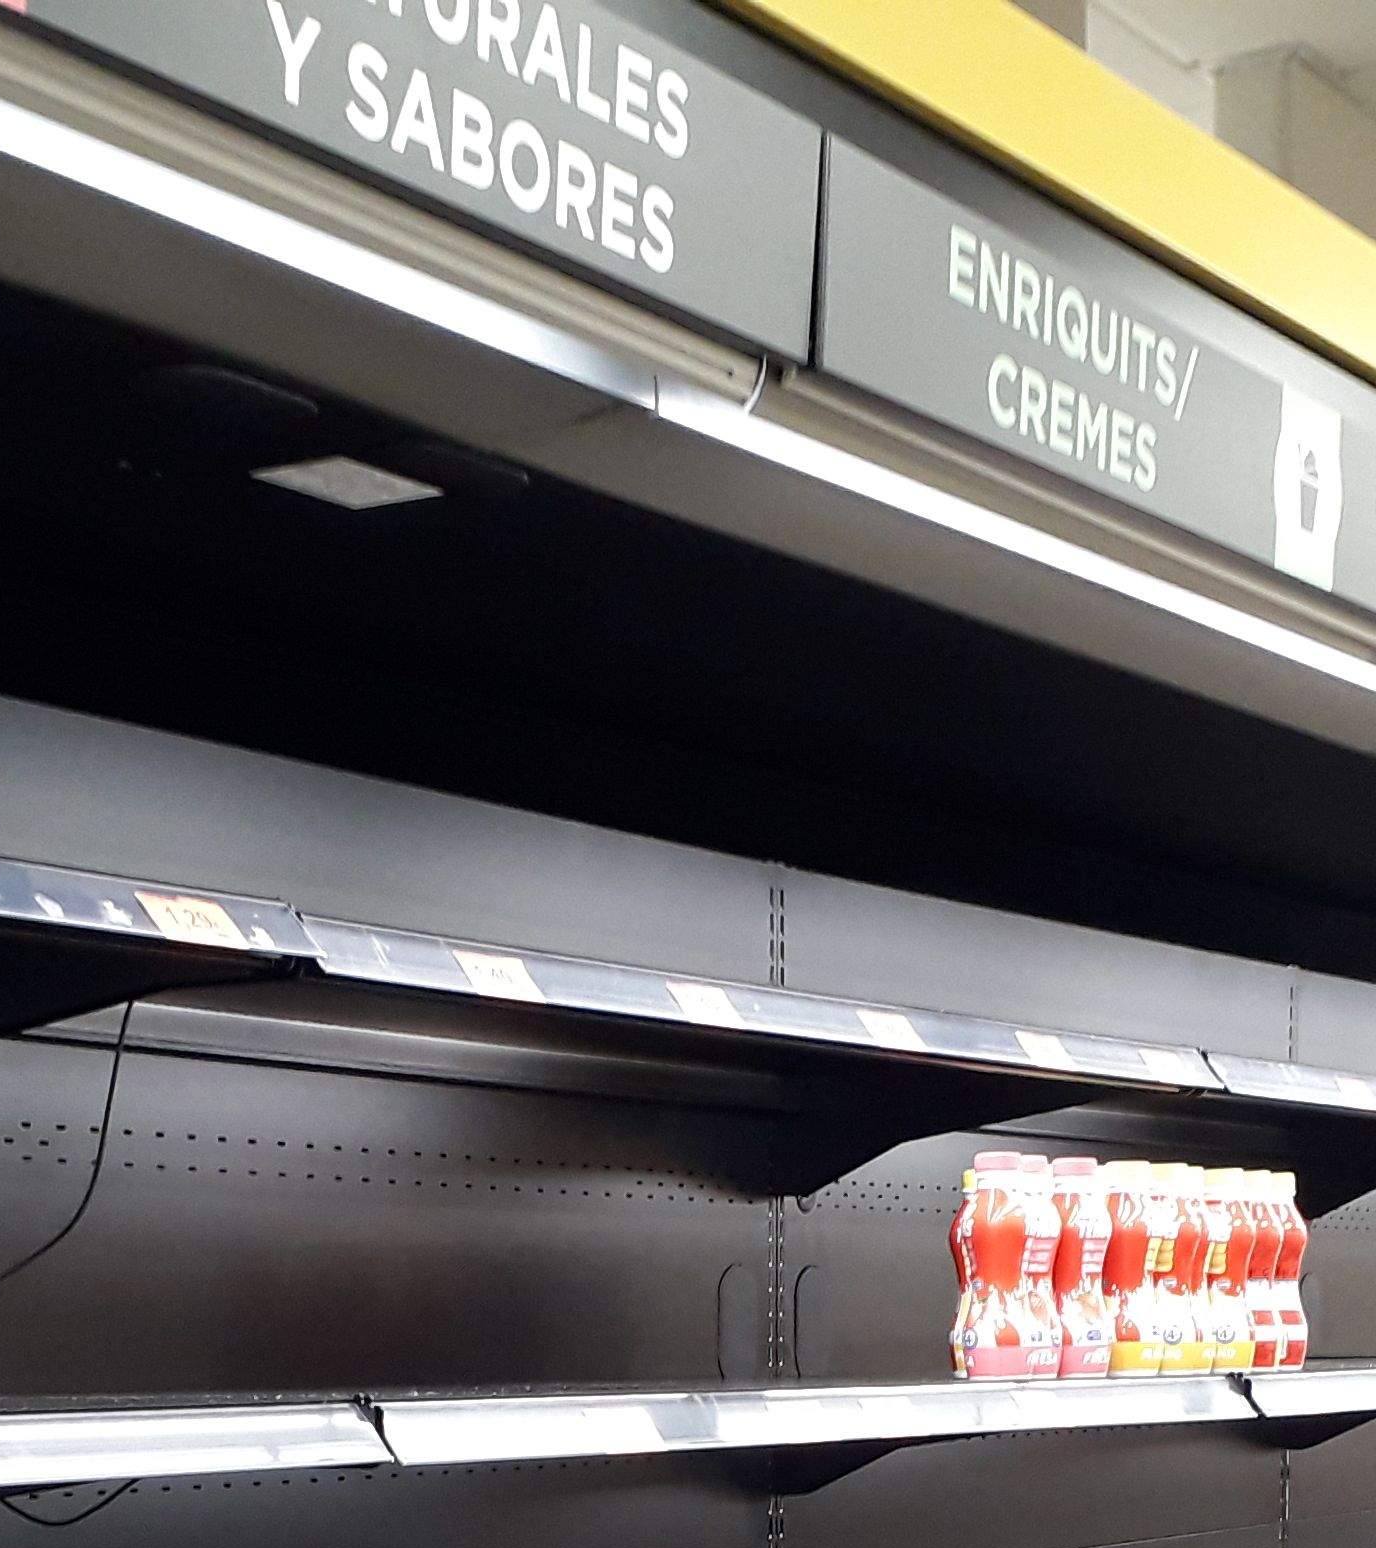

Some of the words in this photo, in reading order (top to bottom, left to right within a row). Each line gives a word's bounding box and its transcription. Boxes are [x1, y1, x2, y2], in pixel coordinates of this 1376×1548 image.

[266, 0, 322, 105] Y
[345, 41, 676, 274] SABORES
[947, 223, 1200, 422] ENRIQUITS/
[986, 352, 1158, 493] CREMES
